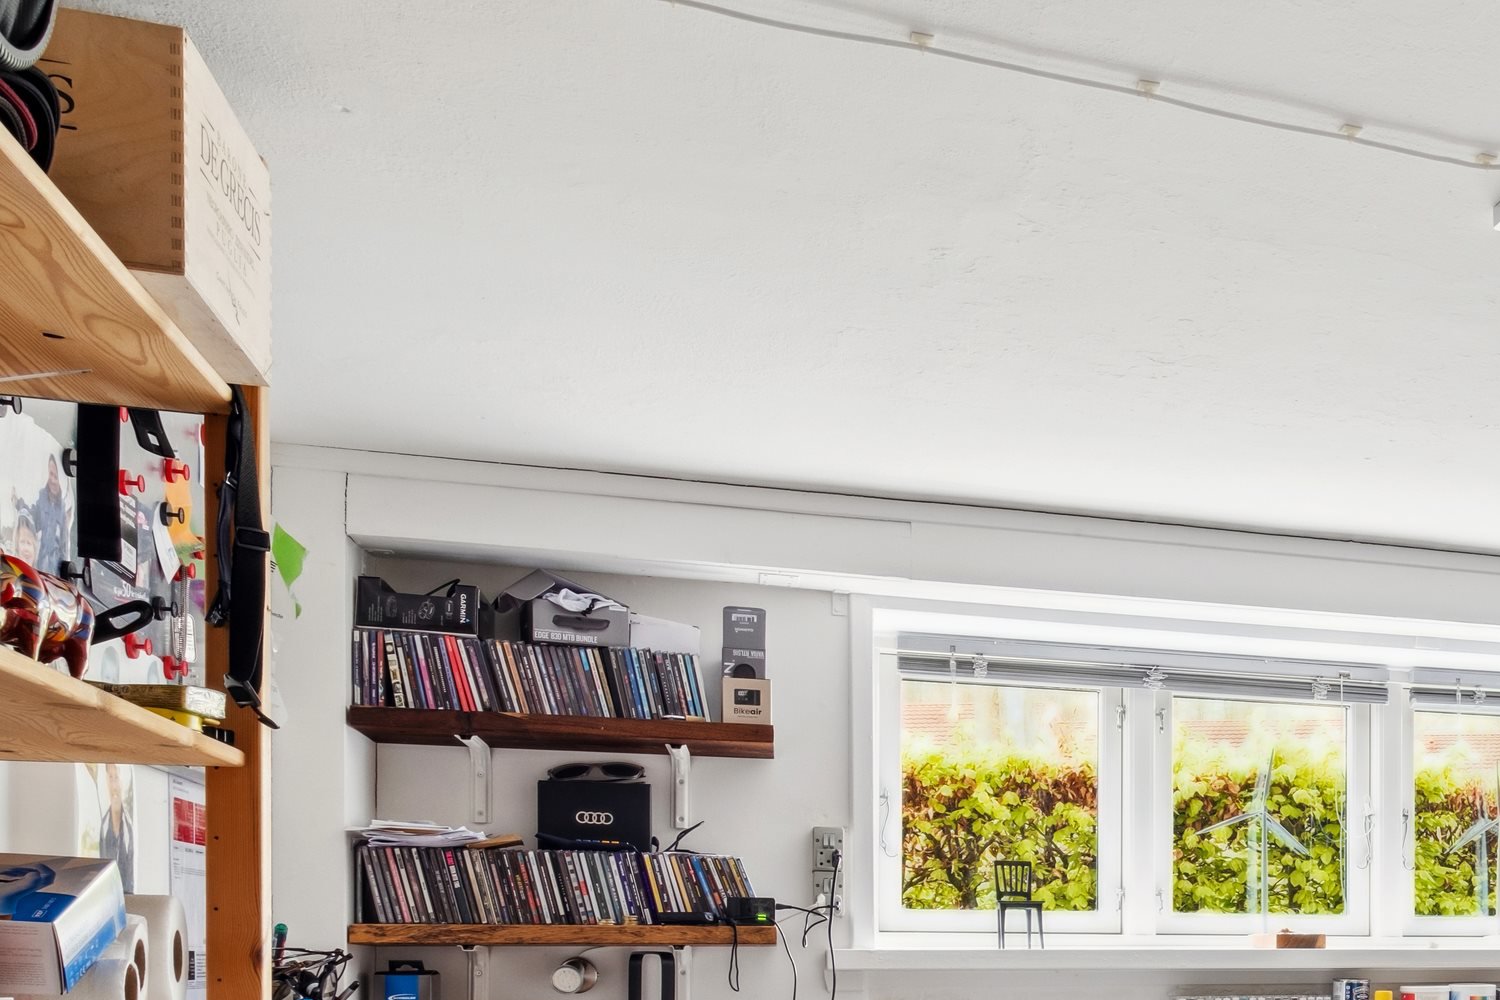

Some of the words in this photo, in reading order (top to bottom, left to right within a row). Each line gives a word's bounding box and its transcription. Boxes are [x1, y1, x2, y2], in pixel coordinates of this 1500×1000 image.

[200, 123, 218, 181] DE
[220, 159, 261, 246] GRECIS
[534, 631, 549, 639] EDGE
[550, 632, 562, 640] 830
[562, 633, 575, 641] MTB
[575, 634, 598, 643] BUNDLE
[733, 707, 762, 716] Bikeair
